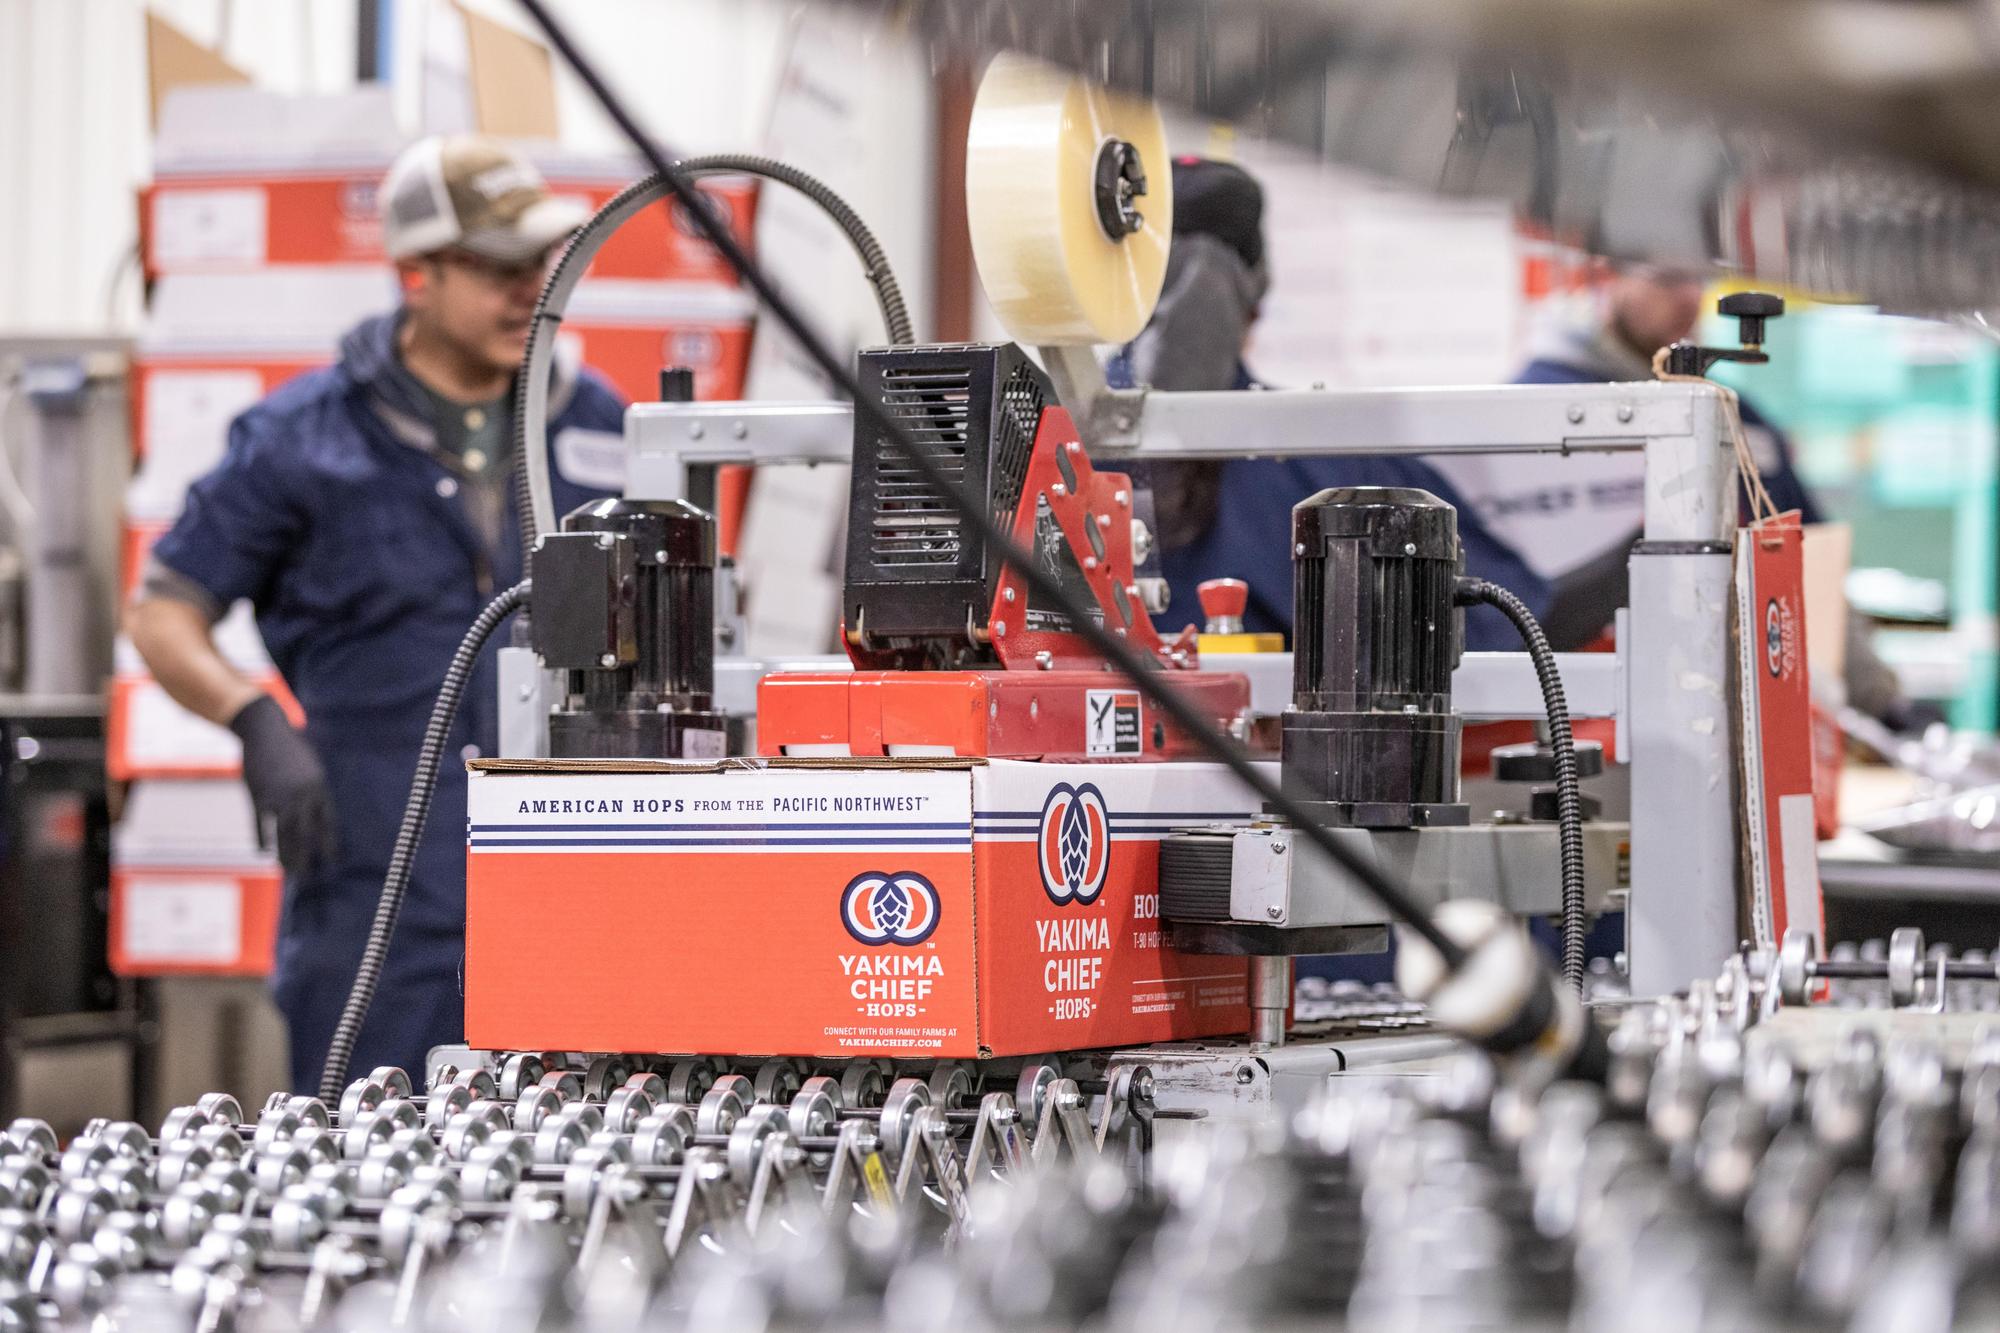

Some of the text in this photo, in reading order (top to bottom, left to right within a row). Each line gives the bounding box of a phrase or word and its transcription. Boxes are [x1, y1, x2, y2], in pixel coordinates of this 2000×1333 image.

[518, 799, 623, 813] AMERICAN
[633, 799, 685, 813] HOPS
[693, 800, 732, 811] FROM
[737, 800, 764, 811] THE
[773, 797, 828, 811] PACIFIC
[1036, 918, 1111, 952] YAKIMA
[838, 955, 944, 976] YAKIMA
[1044, 957, 1102, 993] CHIEF
[850, 979, 933, 1000] CHIEF
[824, 1026, 958, 1037] CONNECT WITH OUR FAMILY FARMS AT
[838, 1038, 942, 1048] YAKIMACHIEF.COM
